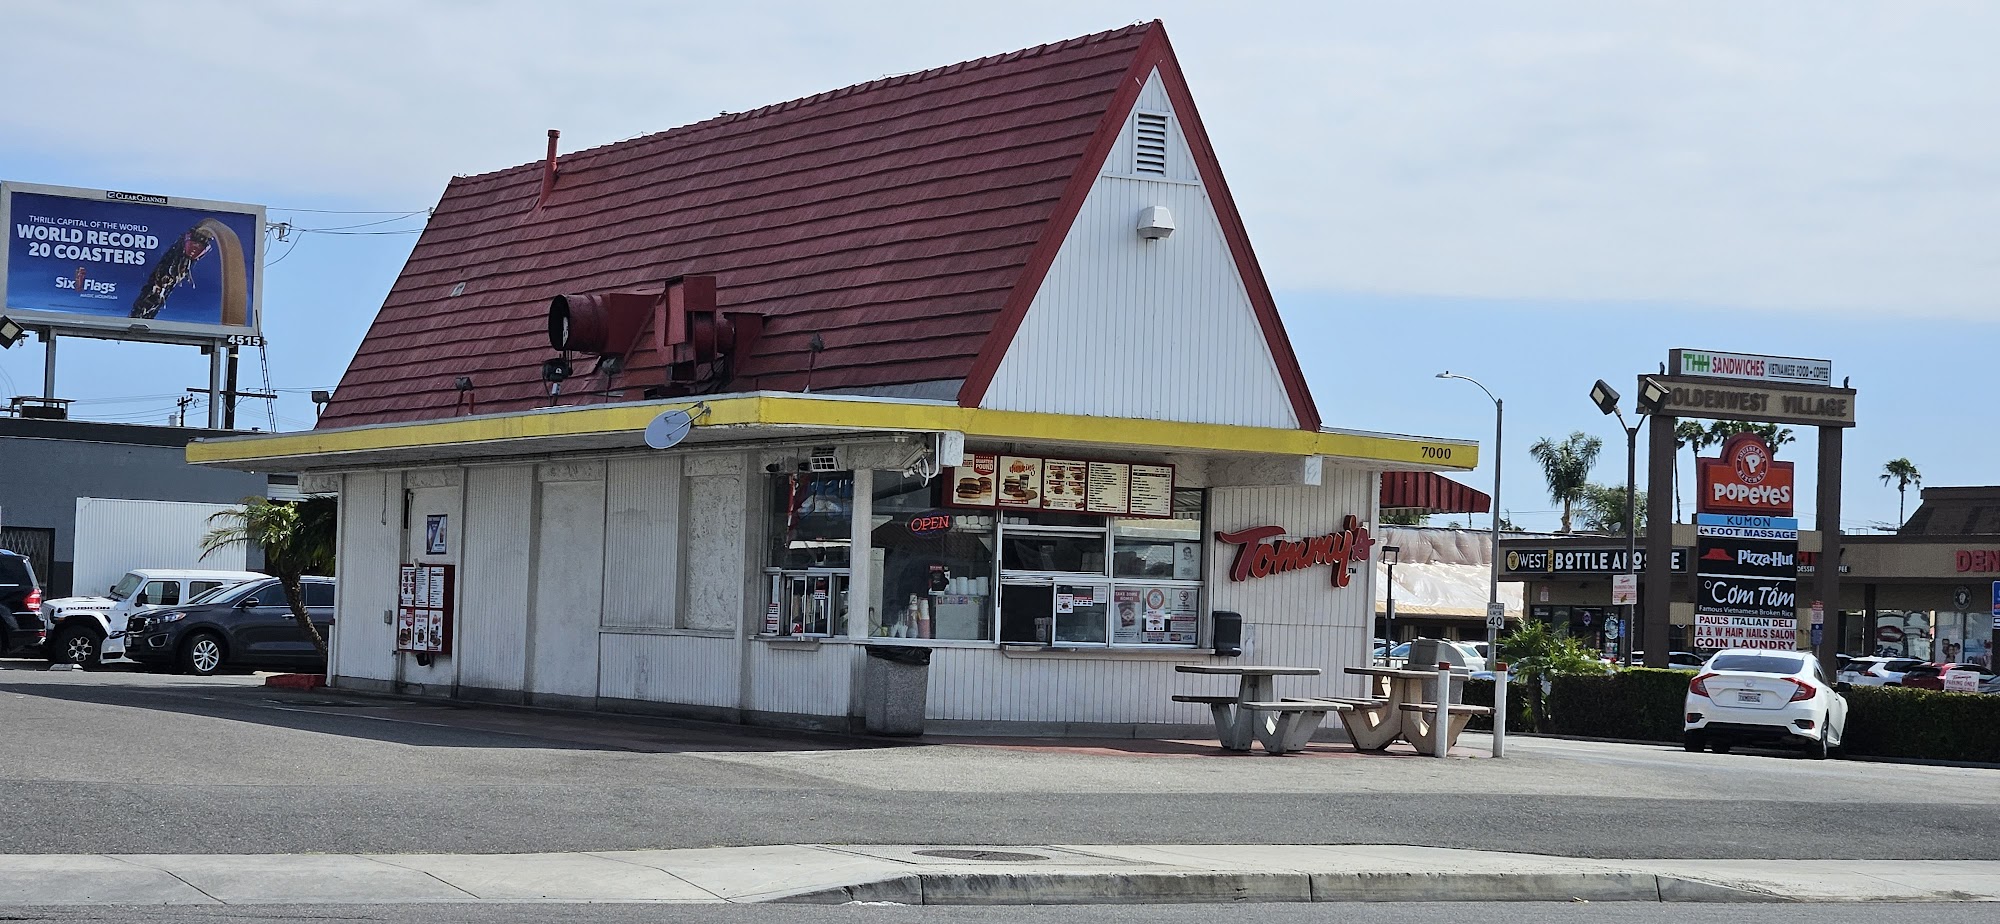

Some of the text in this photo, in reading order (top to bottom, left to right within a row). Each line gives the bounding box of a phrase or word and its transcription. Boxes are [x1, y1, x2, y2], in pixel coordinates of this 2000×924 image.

[29, 215, 55, 224] THRILL
[57, 218, 88, 227] CAPITAL
[119, 224, 148, 232] WORLD
[17, 224, 159, 249] WORLD RECORD
[29, 242, 145, 265] 20 COASTERS
[55, 277, 116, 294] Six Flags
[228, 335, 260, 345] 4515
[1712, 357, 1765, 377] SANDWICHES
[1768, 363, 1828, 378] VIETNAMESE FOOD COFFEE
[1781, 395, 1847, 416] VILLAGE
[1421, 447, 1451, 459] 7000
[1738, 446, 1766, 462] LOUISIANA
[1745, 454, 1760, 473] P
[1738, 470, 1765, 482] KITCHEN
[911, 516, 949, 531] OPEN
[1727, 516, 1770, 527] KUMON
[1711, 528, 1796, 538] FOOT MASSAGE
[1214, 515, 1376, 588] Tommy's
[1738, 550, 1770, 566] Pizza
[1772, 552, 1793, 567] Hut
[1519, 554, 1547, 568] WEST
[1555, 552, 1608, 570] BOTTLE
[1489, 617, 1502, 626] 40
[1700, 616, 1728, 624] PAUL'S
[1732, 617, 1769, 626] ITALIAN
[1697, 627, 1795, 639] A & W HAIR NAILS SALON
[1696, 638, 1795, 649] COIN LAUNDRY
